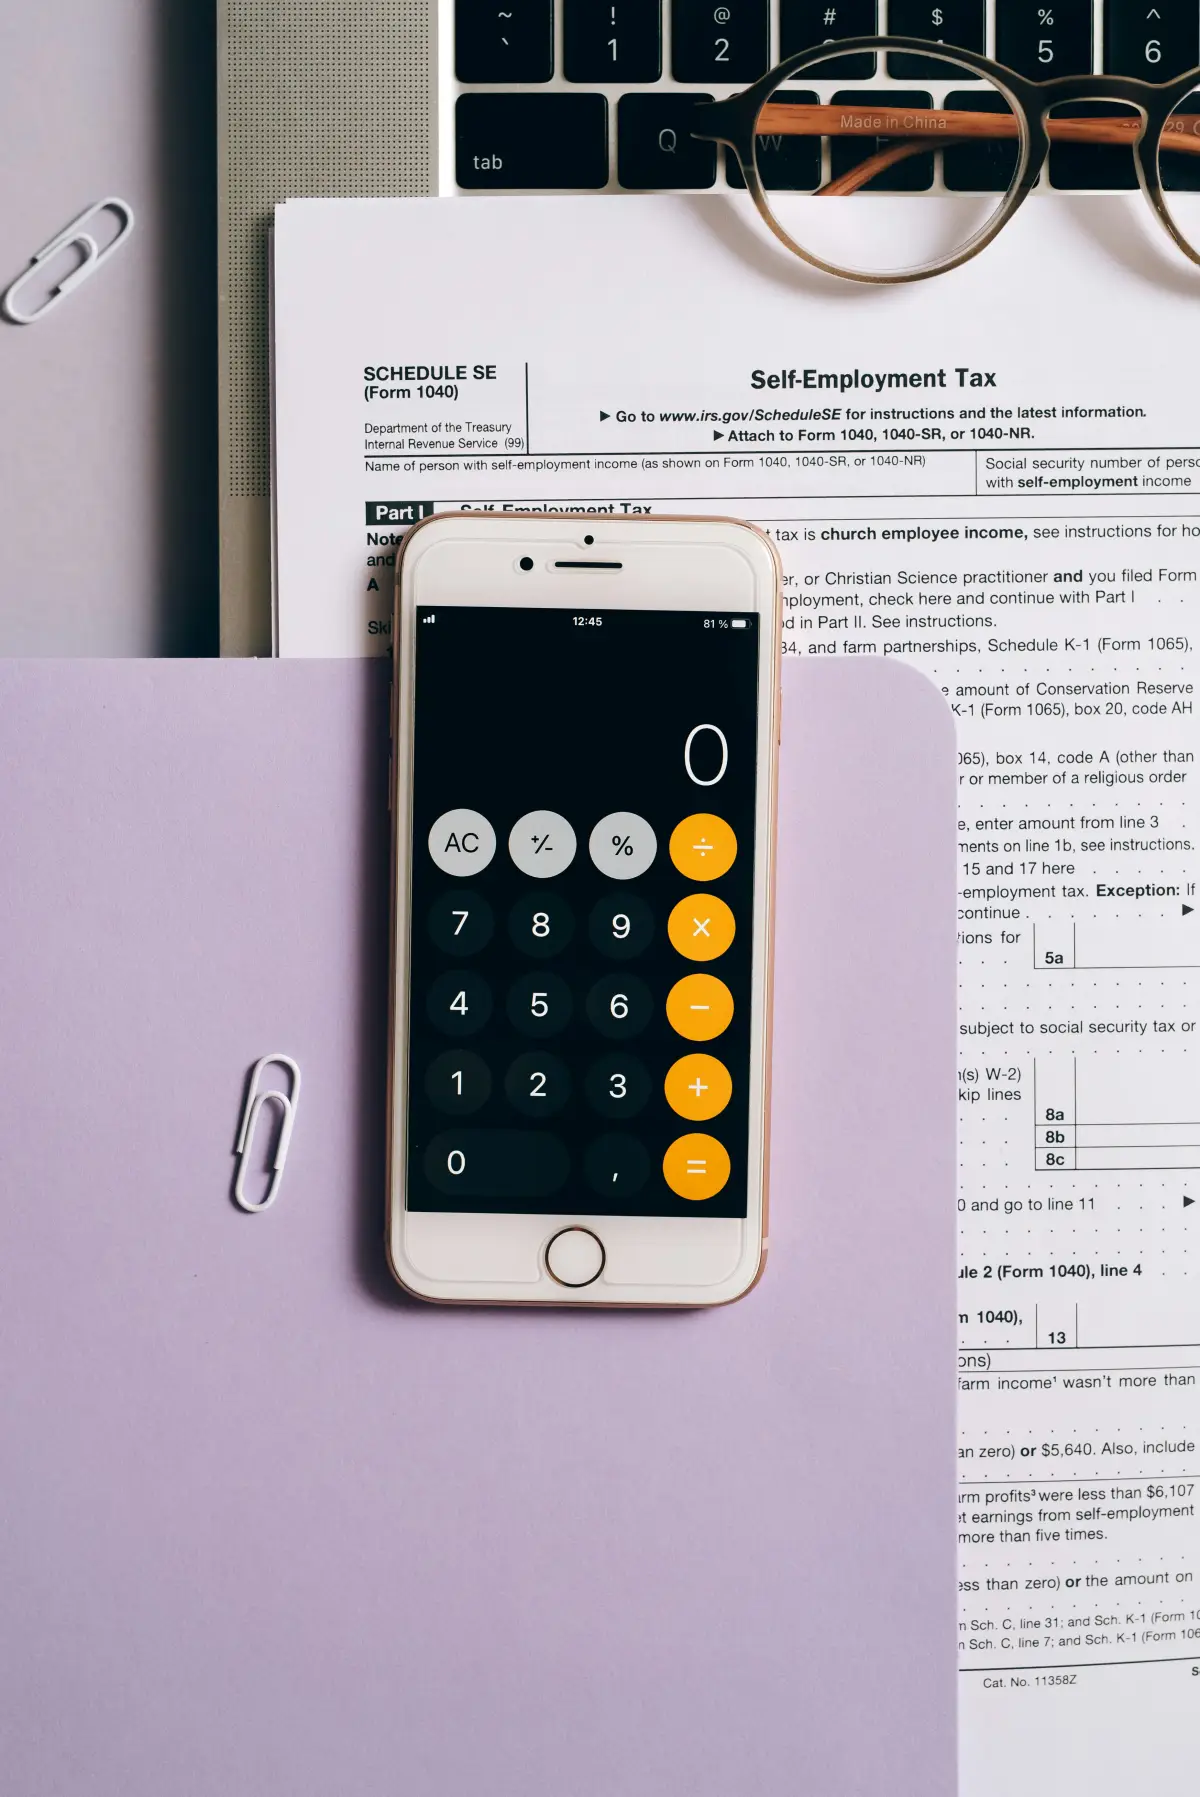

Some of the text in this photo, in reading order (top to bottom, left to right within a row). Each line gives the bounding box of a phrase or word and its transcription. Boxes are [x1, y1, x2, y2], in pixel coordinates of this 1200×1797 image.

[607, 38, 617, 62] 1
[714, 38, 730, 62] 2
[1038, 40, 1054, 64] 5
[1144, 40, 1162, 64] 6
[840, 115, 947, 129] Made in China
[658, 128, 677, 154] Q
[472, 154, 503, 170] tab
[364, 365, 497, 381] SCHEDULE SE
[751, 368, 997, 394] Self-Employment Tax
[364, 385, 459, 402] (Form 1040)
[615, 405, 1147, 424] Go to www.irs.gov/ScheduleSE for instructions and the latest information.
[364, 421, 512, 436] Department of the Treasury
[728, 427, 1035, 443] Attach to Form 1040, 1040-SR, or 1040-NR.
[364, 437, 525, 450] Internal Revenue Service (99)
[365, 455, 926, 475] Name of person with self-employment income (as shown on Form 1040, 1040-SR, or 1040-NR)
[985, 457, 1027, 470] Social
[1032, 457, 1085, 472] security
[1090, 457, 1142, 469] number
[1147, 456, 1161, 468] of
[985, 475, 1192, 491] with self-employment income
[375, 505, 414, 521] Part
[775, 529, 798, 541] tax
[804, 528, 816, 541] is
[820, 527, 877, 541] church
[881, 526, 960, 543] employee
[964, 525, 1028, 541] income,
[1033, 528, 1060, 540] see
[1064, 524, 1152, 539] instructions
[1156, 524, 1178, 537] for
[366, 578, 379, 592] A
[804, 575, 820, 586] or
[825, 571, 892, 586] Christian
[897, 570, 958, 585] Science
[963, 569, 1049, 587] practitioner
[1053, 569, 1083, 583] and
[1088, 572, 1116, 587] you
[1121, 568, 1153, 582] filed
[1158, 569, 1197, 582] Form
[572, 616, 603, 627] 12:45
[703, 619, 715, 629] 81
[800, 616, 813, 629] in
[818, 616, 849, 629] Part
[871, 615, 901, 629] See
[905, 613, 997, 628] instructions.
[808, 637, 1193, 658] and farm partnerships, Schedule K-1 (Form 1065),
[955, 681, 1194, 697] amount of Conservation Reserve
[684, 723, 729, 787] 0
[975, 818, 1014, 831] enter
[1018, 816, 1075, 830] amount
[1079, 815, 1115, 829] from
[1119, 815, 1146, 828] line
[1151, 816, 1160, 828] 3
[444, 832, 480, 854] AC
[611, 835, 634, 856] %
[1062, 886, 1089, 898] tax.
[1096, 883, 1180, 900] Exception:
[1186, 882, 1196, 896] If
[451, 910, 469, 936] 7
[531, 912, 551, 938] 8
[612, 913, 631, 939] 9
[1044, 951, 1064, 965] 5a
[449, 990, 469, 1016] 4
[530, 992, 549, 1018] 5
[610, 993, 629, 1019] 6
[959, 1019, 1197, 1037] subject to social security tax or
[451, 1070, 462, 1096] 1
[529, 1071, 547, 1097] 2
[609, 1073, 627, 1099] 3
[1045, 1108, 1065, 1121] 8a
[1045, 1130, 1065, 1144] 8b
[447, 1149, 466, 1175] 0
[1045, 1153, 1065, 1166] 8c
[1047, 1331, 1067, 1345] 13
[1119, 1376, 1157, 1388] more
[1163, 1373, 1196, 1386] than
[978, 1440, 1195, 1461] zero) or $5,640. Also, include
[958, 1527, 1108, 1544] more than five times.
[983, 1674, 1077, 1688] Cat. No. 11358Z
